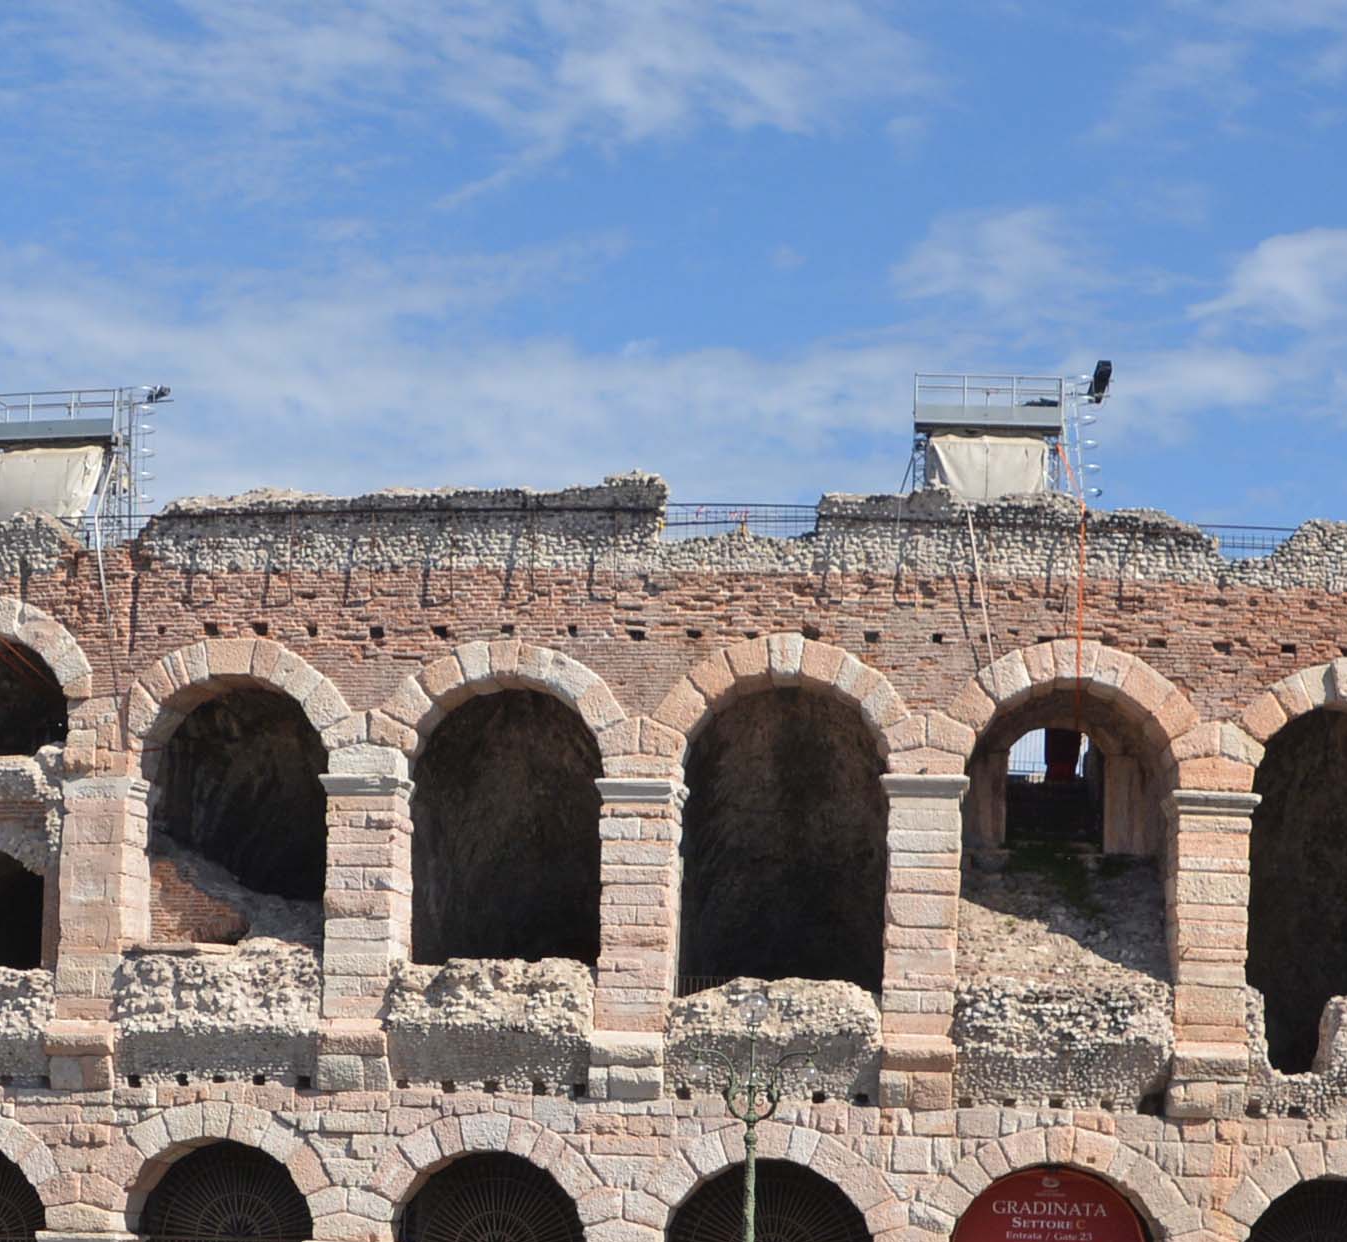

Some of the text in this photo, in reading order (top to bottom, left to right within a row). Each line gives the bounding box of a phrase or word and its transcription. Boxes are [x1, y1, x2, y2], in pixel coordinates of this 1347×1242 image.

[992, 1200, 1107, 1217] GRADINATA
[1011, 1216, 1086, 1231] SETTORE C
[1005, 1230, 1043, 1240] Entrata
[1053, 1231, 1078, 1241] Gate
[1079, 1231, 1093, 1242] 23
